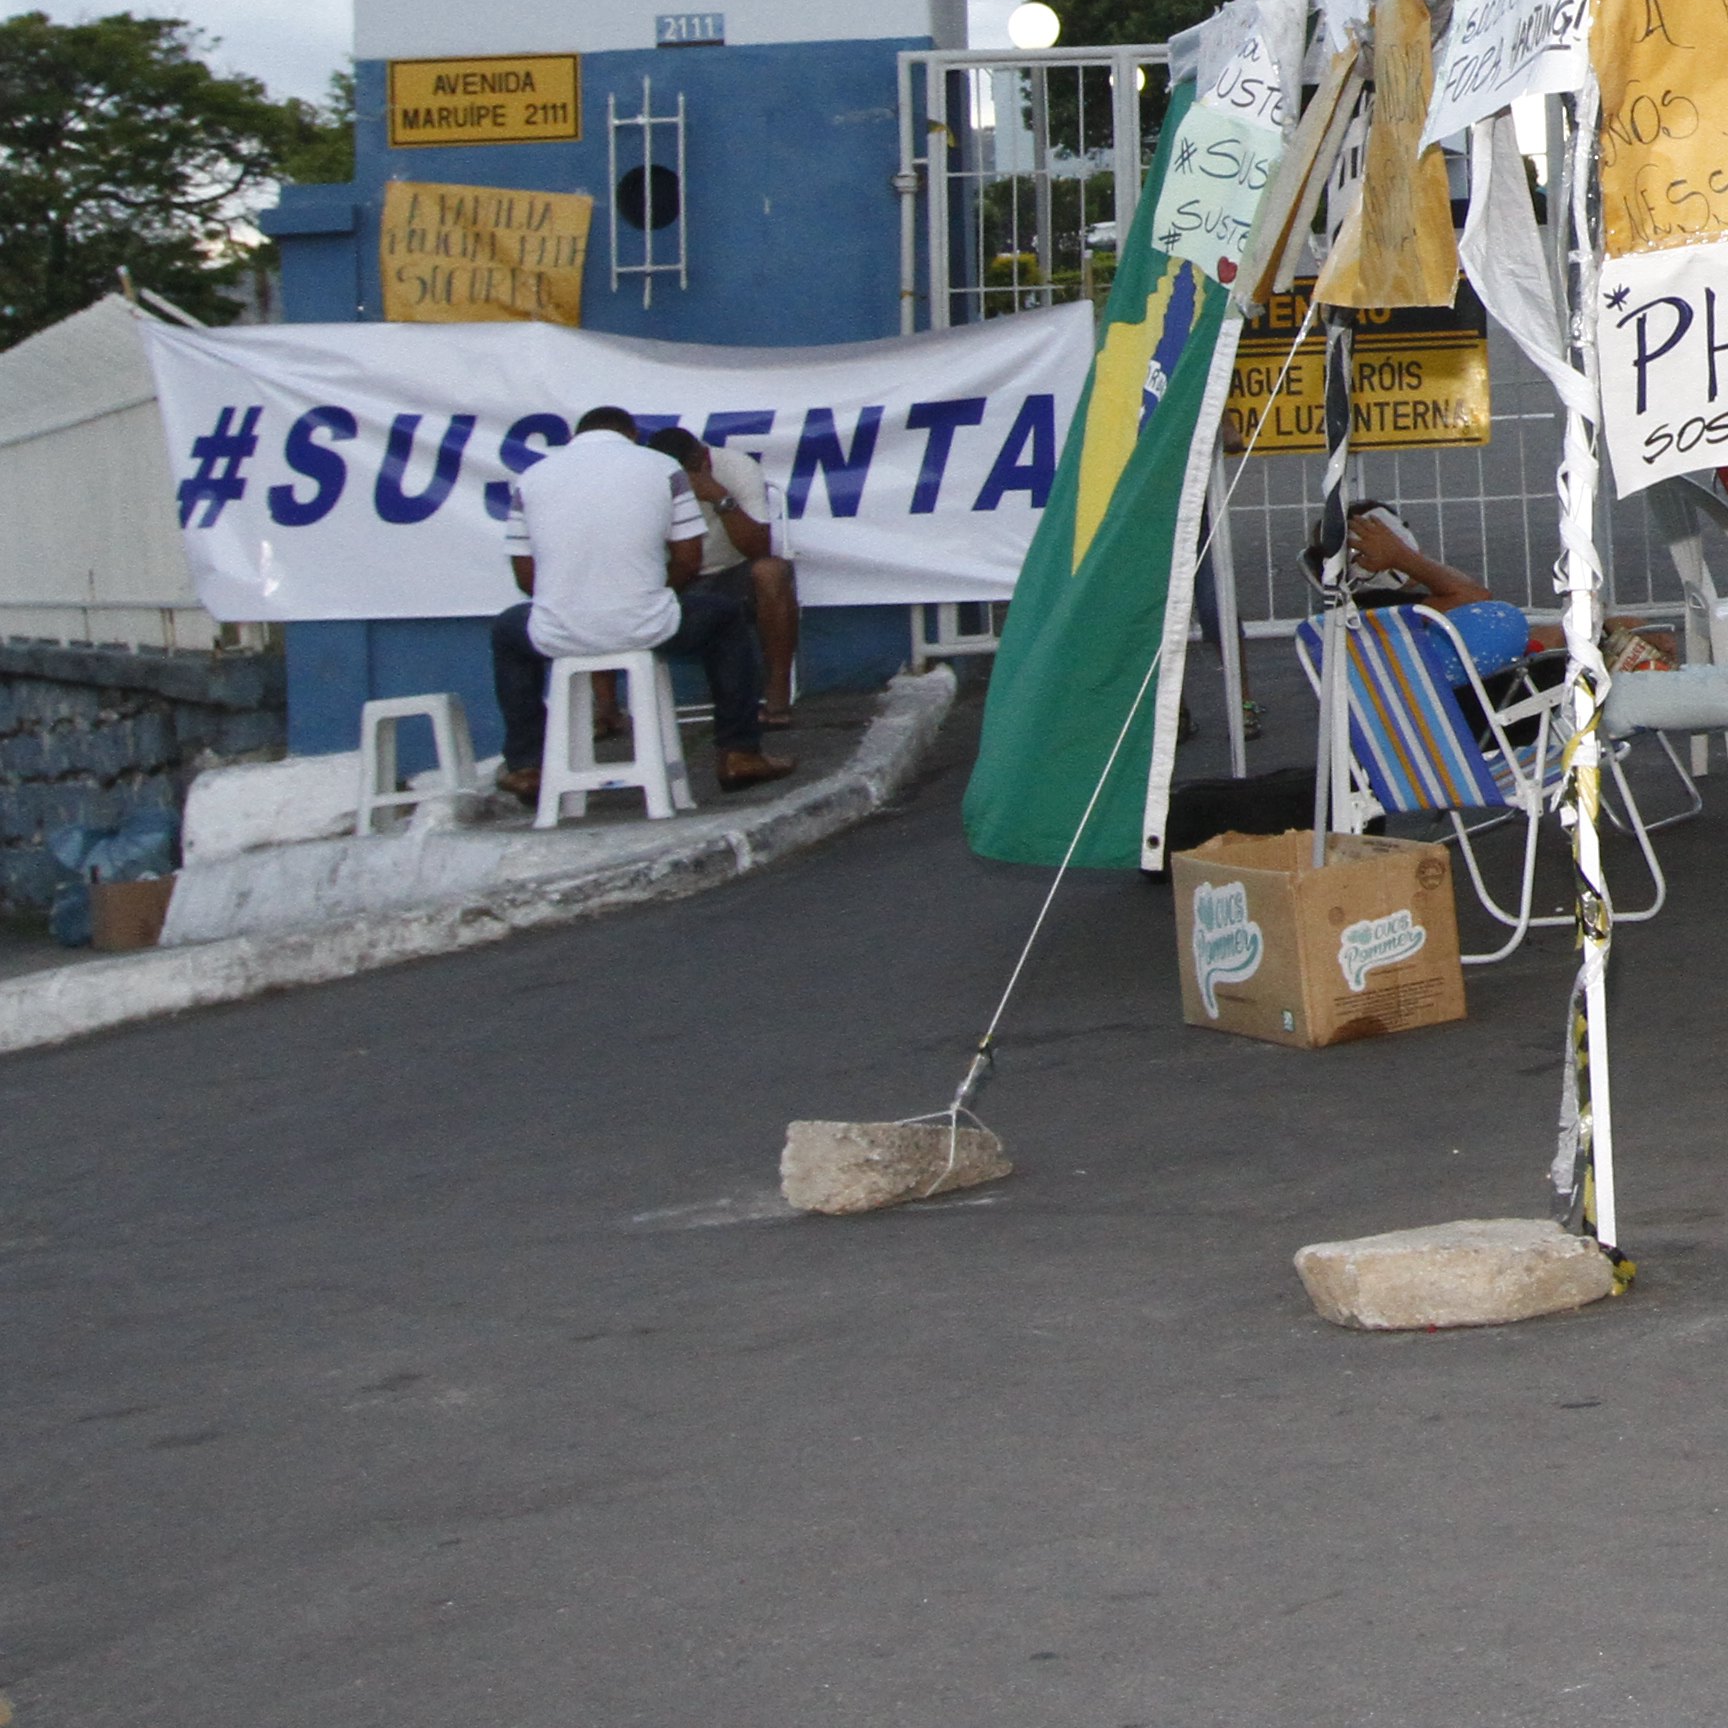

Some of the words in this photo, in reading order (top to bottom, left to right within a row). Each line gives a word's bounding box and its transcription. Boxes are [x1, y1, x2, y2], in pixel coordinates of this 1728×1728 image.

[663, 16, 716, 41] 2111
[432, 71, 536, 96] AVENIDA
[524, 102, 569, 125] 2111
[1353, 398, 1473, 434] NTERNA
[176, 393, 1057, 532] #SUSNTA
